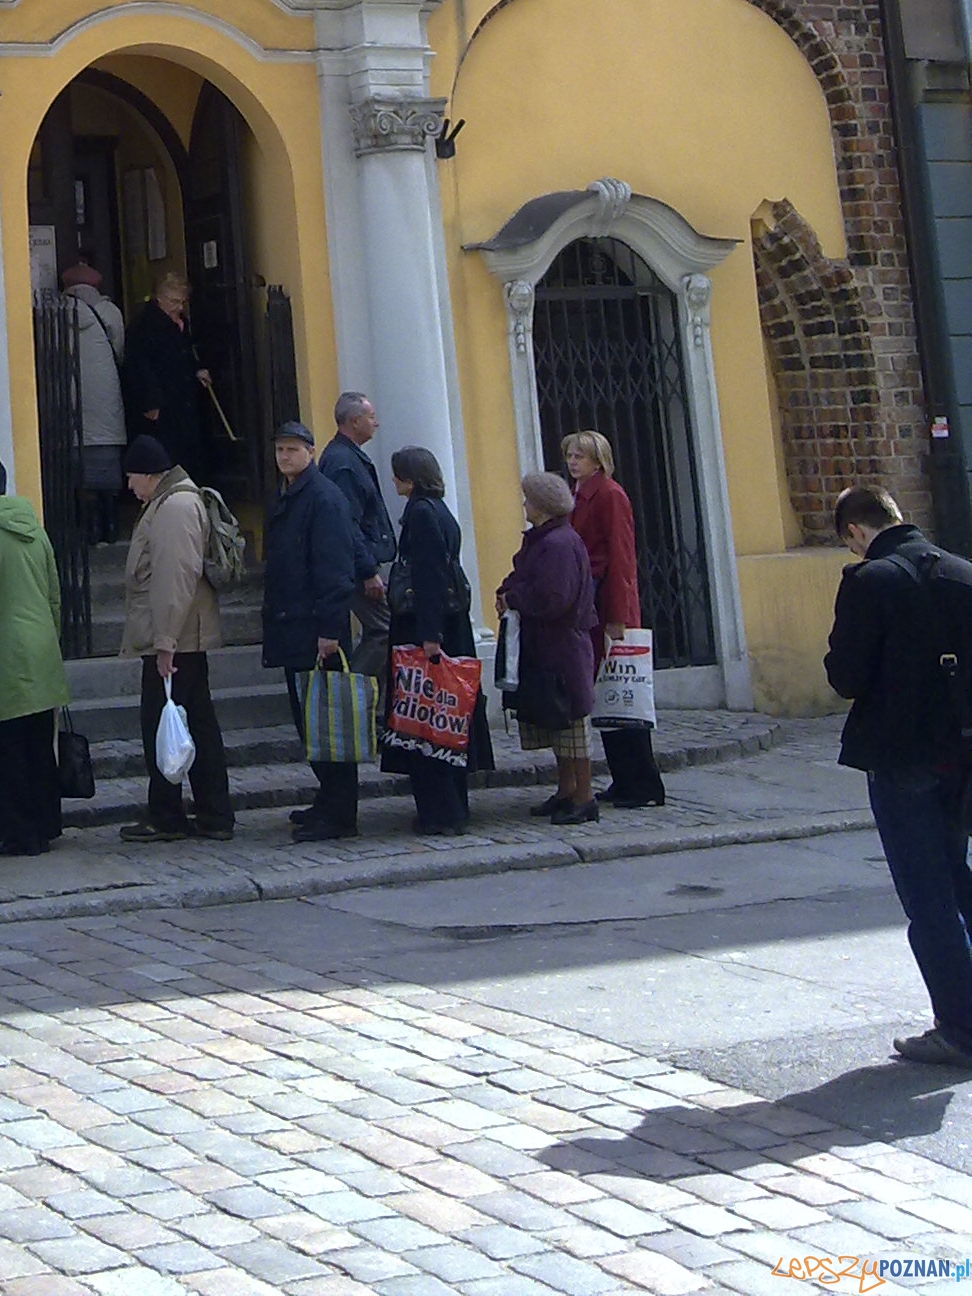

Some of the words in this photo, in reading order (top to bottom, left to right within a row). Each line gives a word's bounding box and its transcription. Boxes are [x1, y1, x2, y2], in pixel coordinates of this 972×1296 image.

[604, 660, 637, 675] Win
[395, 665, 434, 699] Nie
[436, 690, 457, 707] dla
